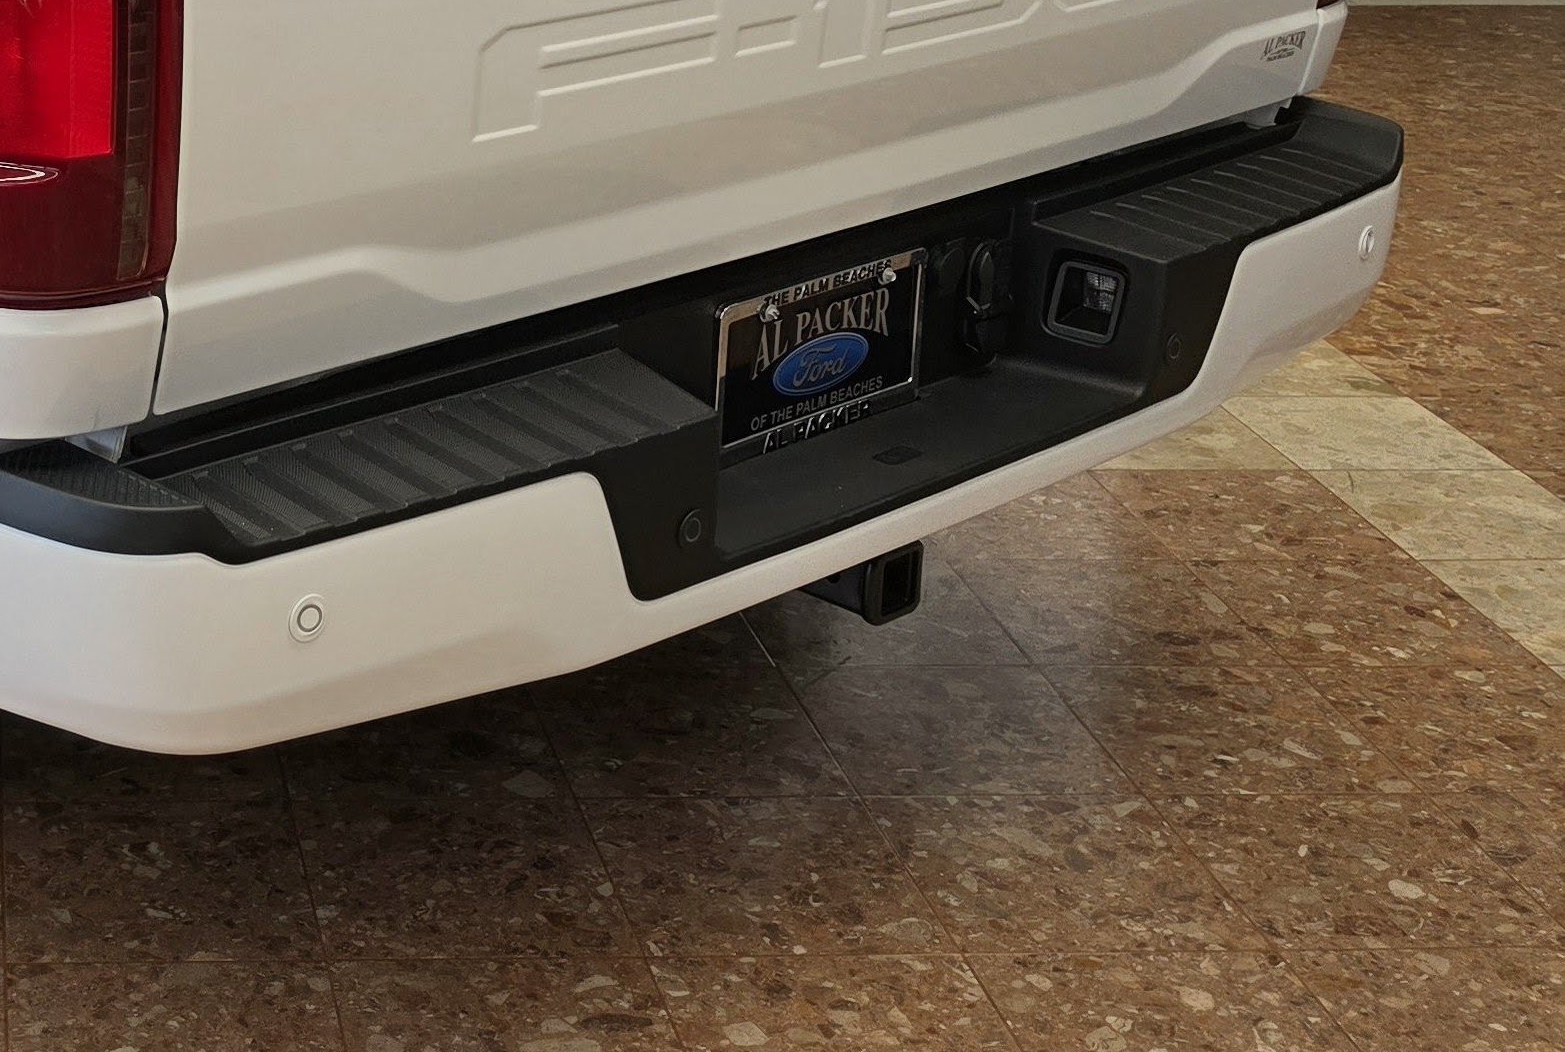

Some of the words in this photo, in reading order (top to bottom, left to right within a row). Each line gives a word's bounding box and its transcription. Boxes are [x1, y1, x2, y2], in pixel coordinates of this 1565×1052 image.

[763, 290, 790, 306] THE
[793, 277, 829, 300] PALM
[833, 259, 892, 288] BEACHES
[751, 319, 789, 381] AL
[794, 287, 889, 336] PACKER
[793, 346, 849, 387] Ford
[750, 414, 768, 431] OF
[771, 406, 793, 424] THE
[796, 393, 827, 415] PALM
[830, 375, 883, 403] BEACHES
